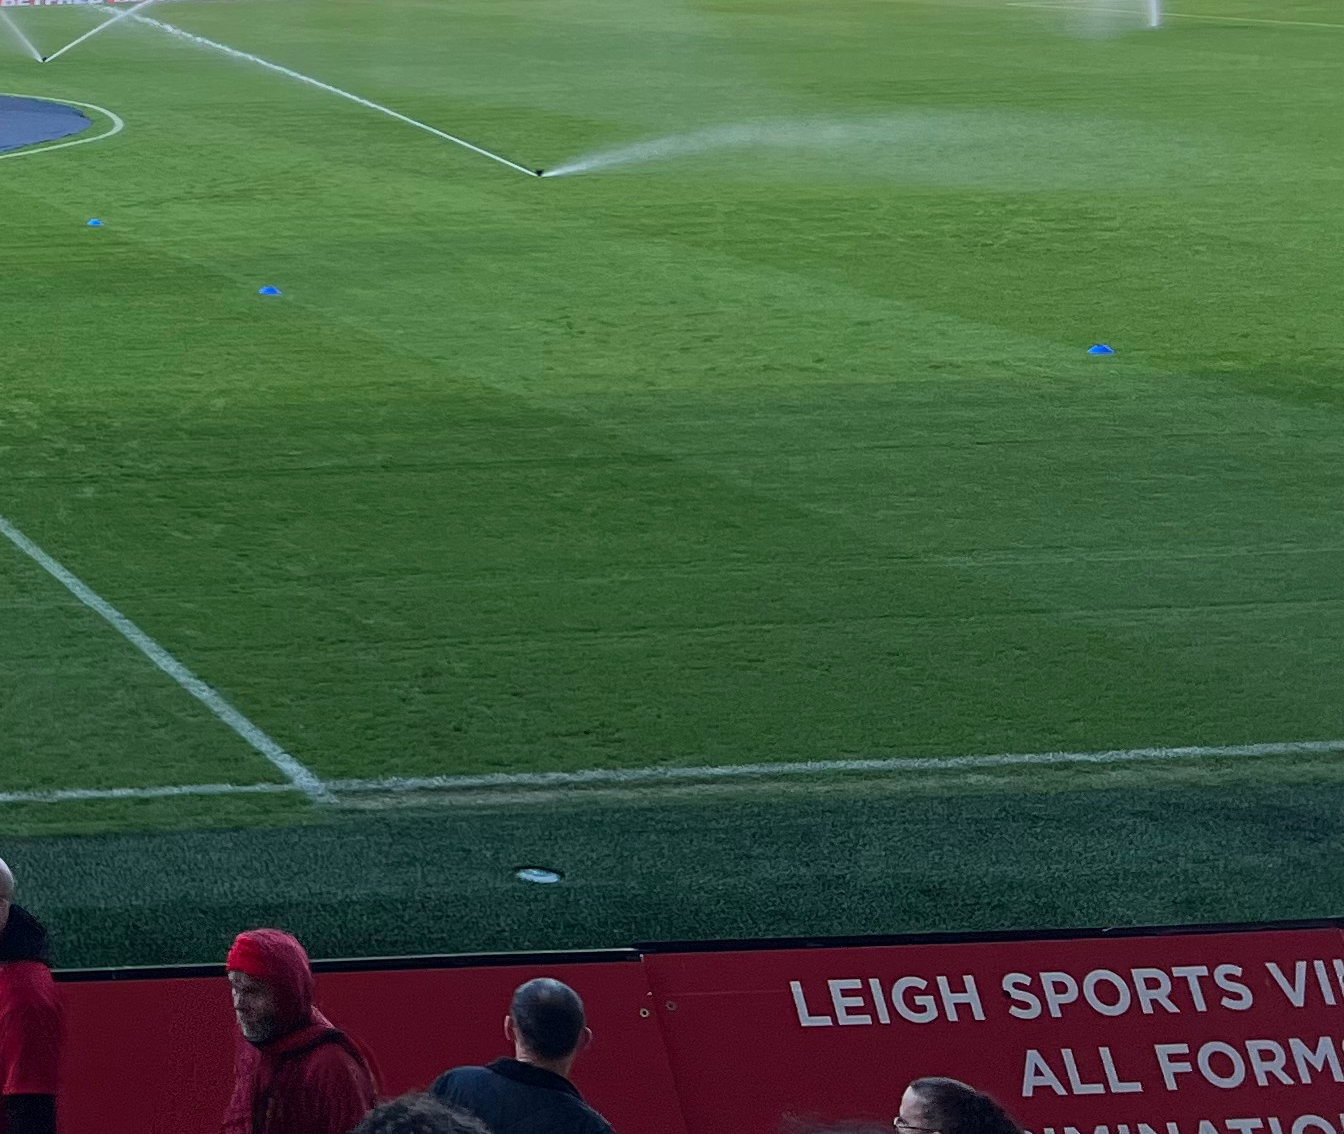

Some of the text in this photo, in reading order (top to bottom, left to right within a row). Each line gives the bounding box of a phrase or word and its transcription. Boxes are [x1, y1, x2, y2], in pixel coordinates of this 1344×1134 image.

[789, 975, 986, 1027] LEIGH
[1001, 964, 1254, 1020] SPORTS
[1021, 1035, 1344, 1097] ALL FORM
